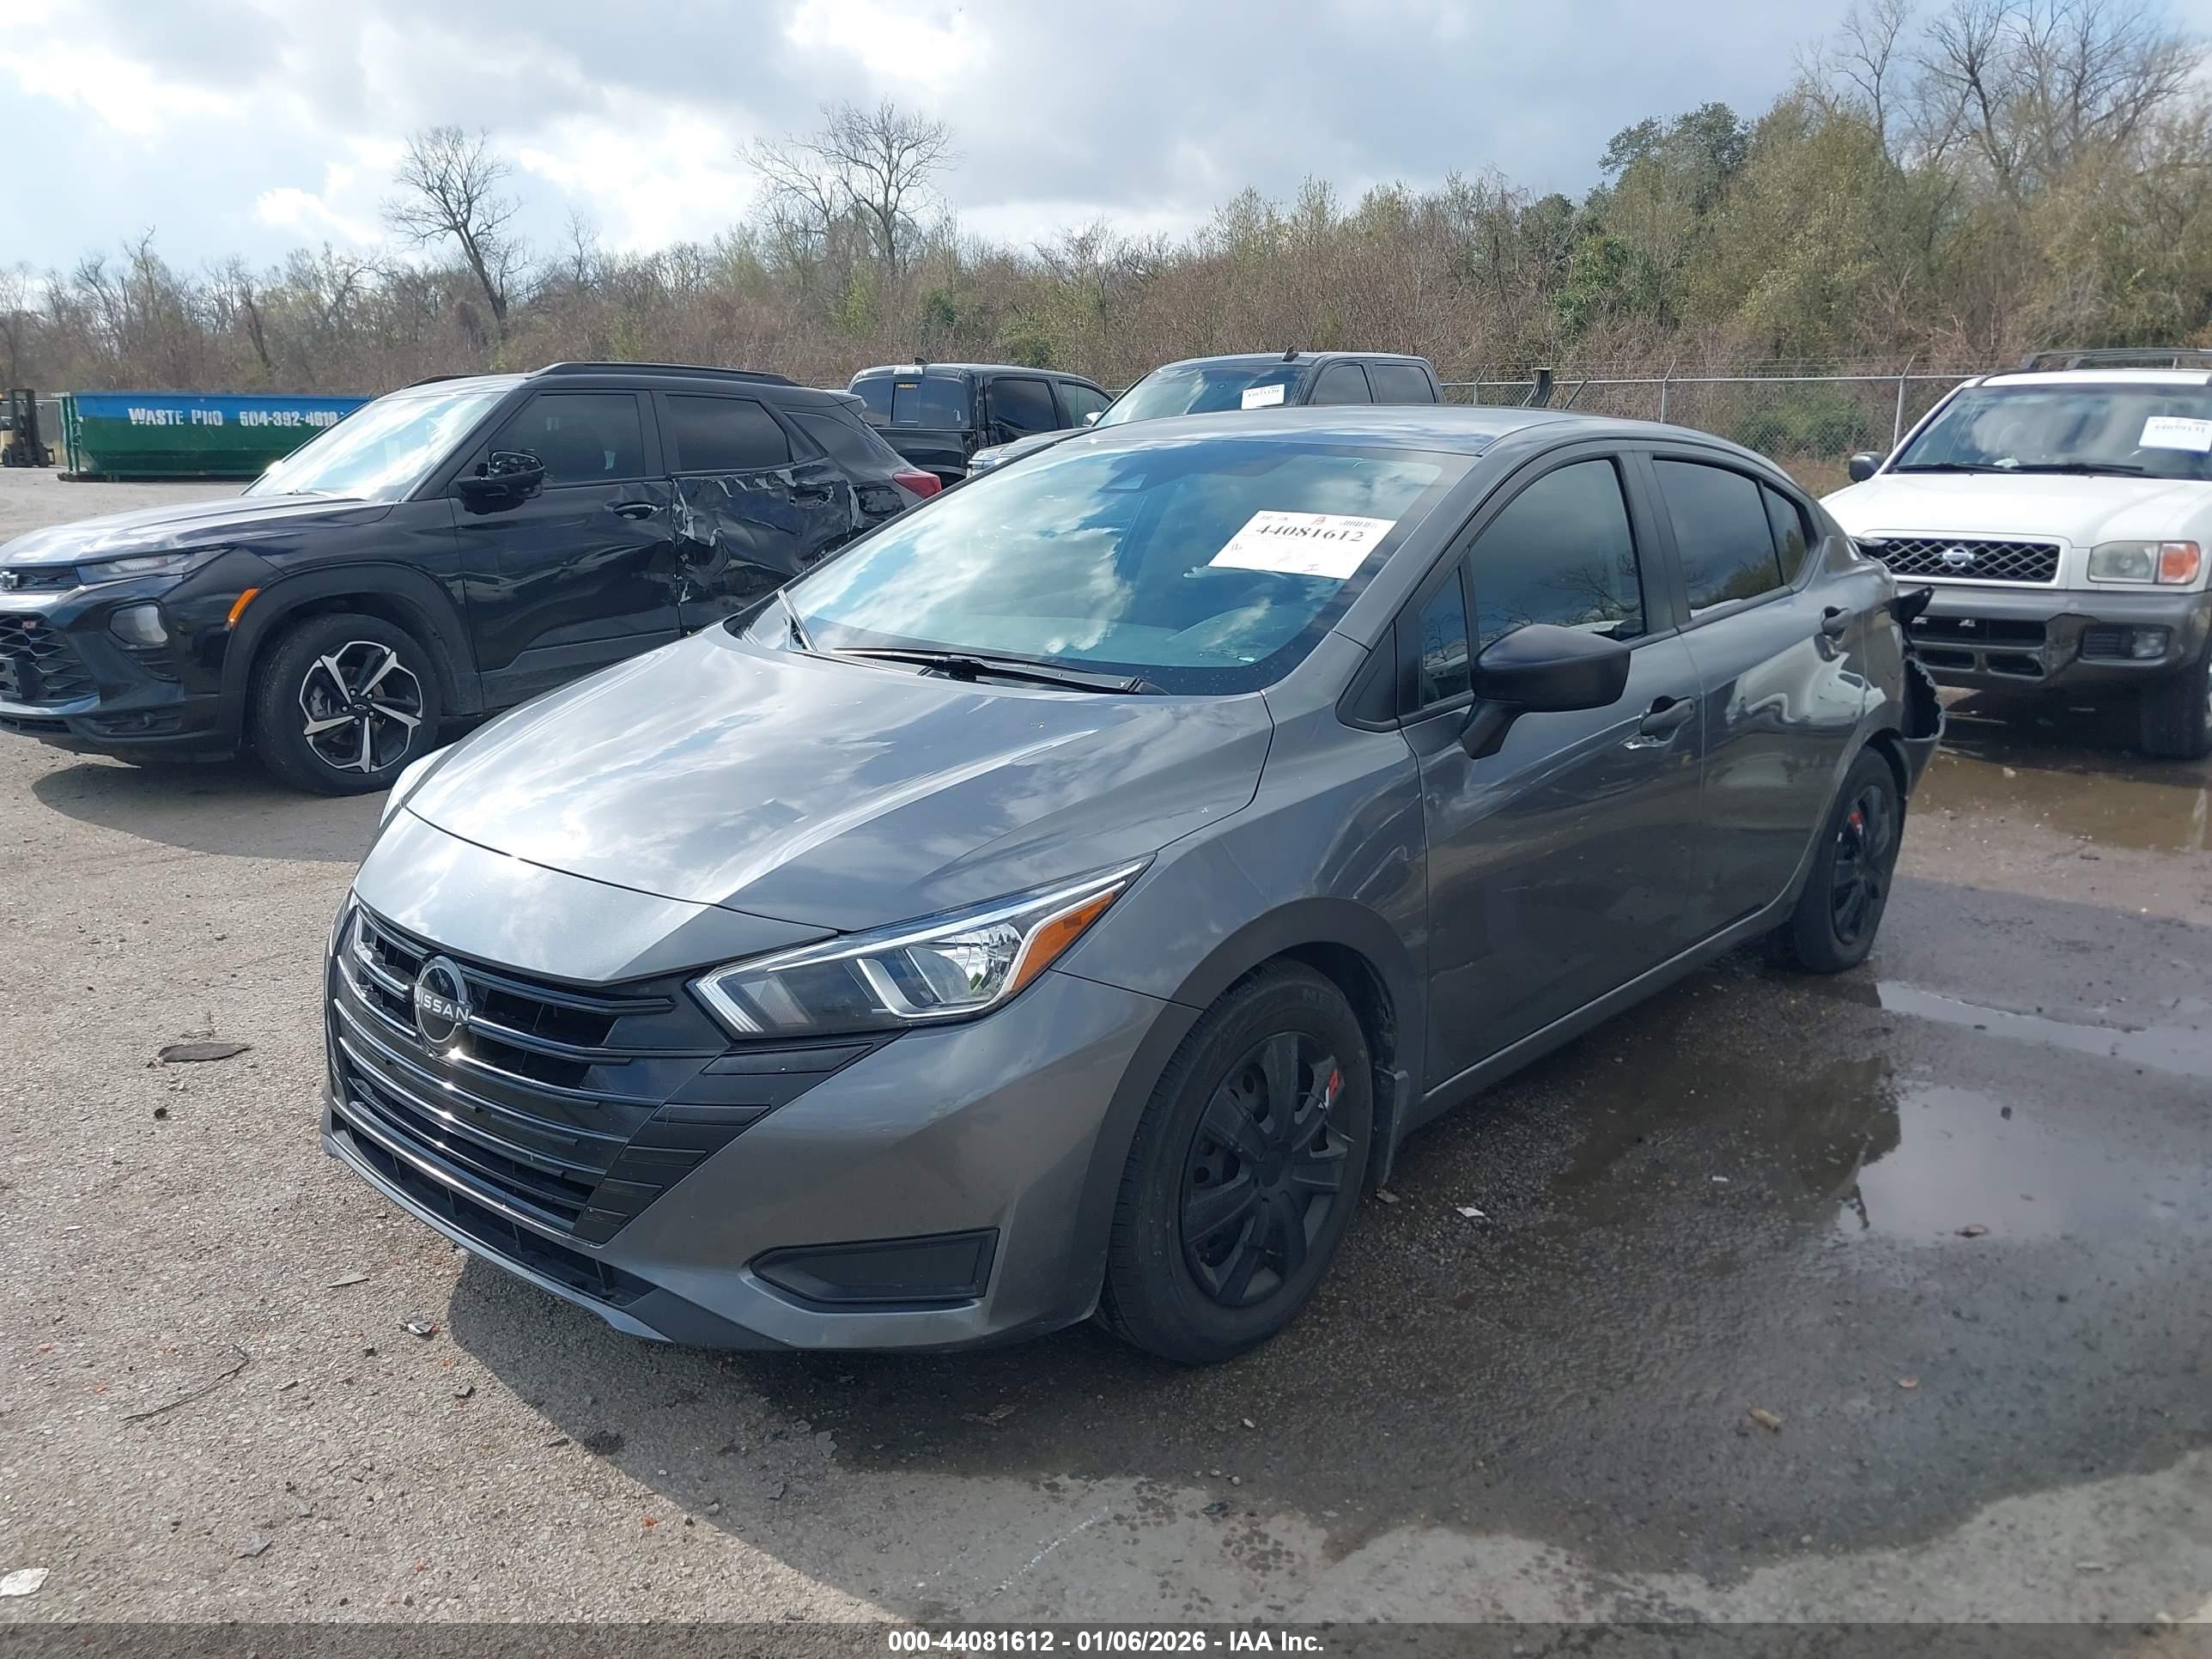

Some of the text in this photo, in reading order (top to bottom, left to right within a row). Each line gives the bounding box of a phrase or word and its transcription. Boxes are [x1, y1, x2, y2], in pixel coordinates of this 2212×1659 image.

[128, 408, 185, 426] WASTE
[1256, 524, 1364, 543] 44081612
[415, 986, 470, 1022] NISSAN
